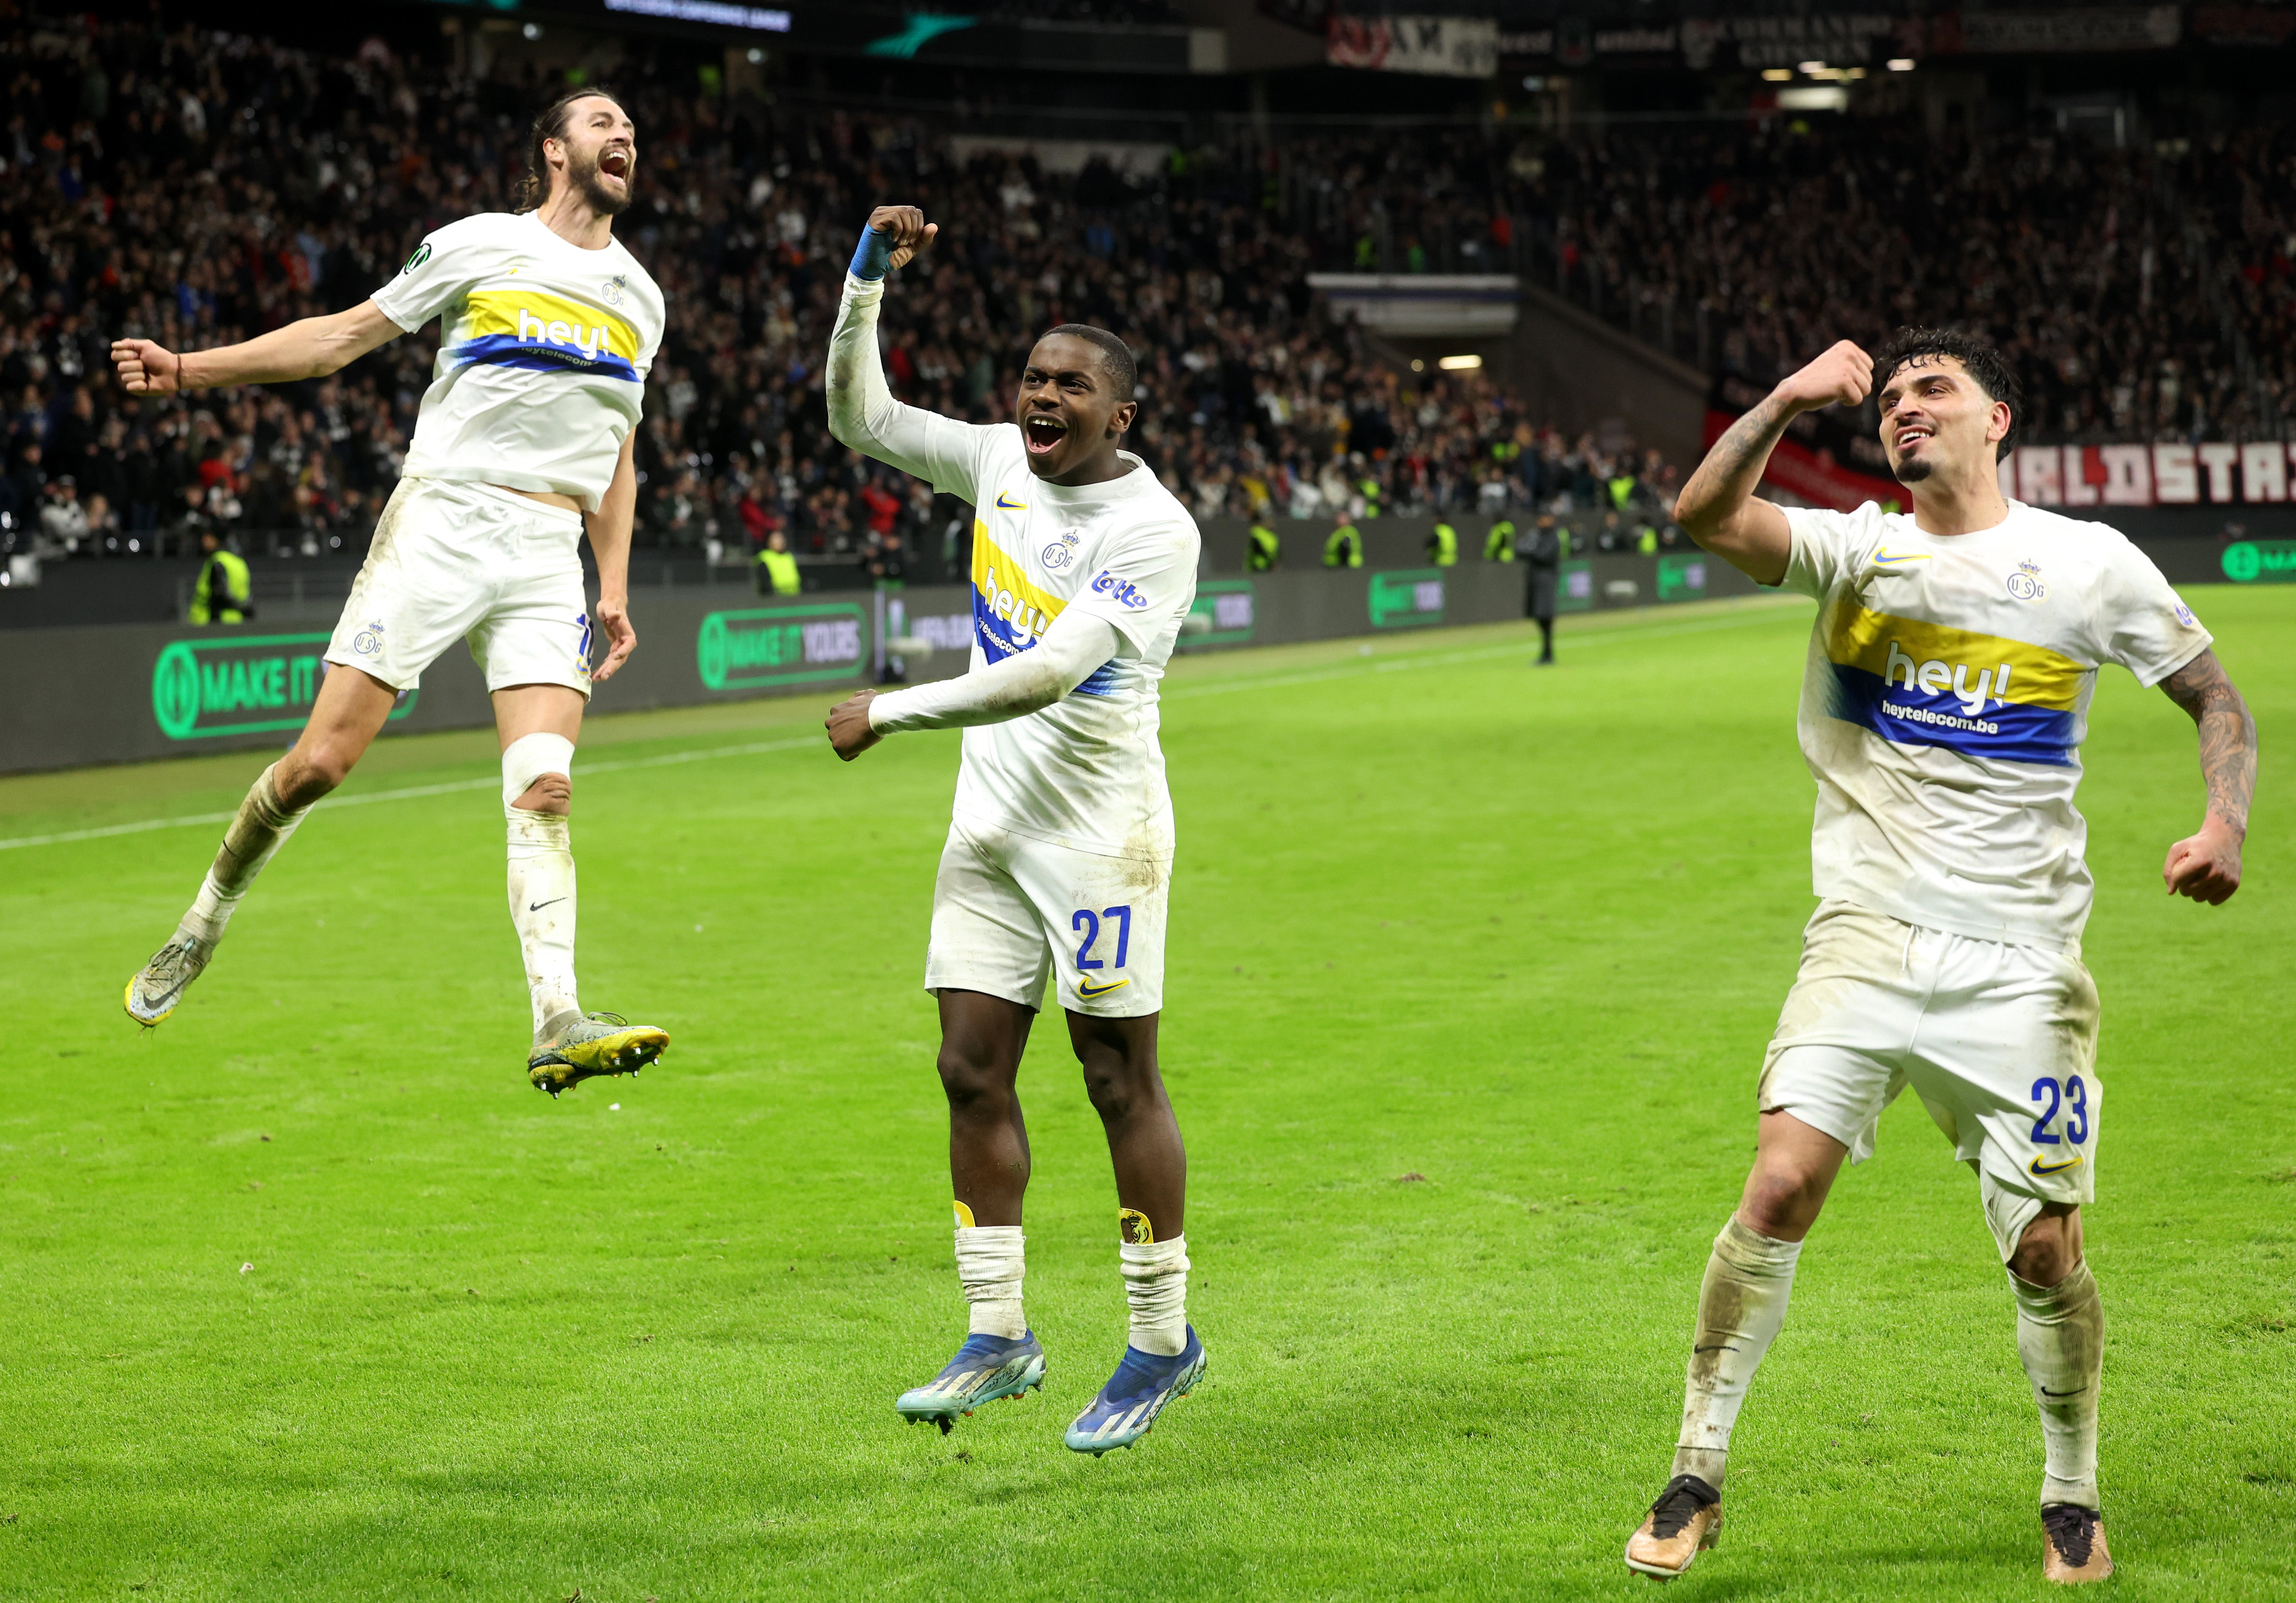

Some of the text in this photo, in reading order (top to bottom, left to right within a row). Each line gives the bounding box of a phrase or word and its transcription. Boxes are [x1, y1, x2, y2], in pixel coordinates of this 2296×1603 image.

[518, 308, 609, 360] hey!
[1046, 547, 1073, 567] USG
[985, 565, 1047, 646] hey!
[2012, 578, 2044, 598] USG
[357, 636, 382, 653] USG
[202, 657, 287, 713] MAKE
[290, 654, 318, 705] IT
[1885, 640, 2012, 716] hey!
[1882, 700, 1999, 735] heytelecom.be
[1072, 905, 1131, 969] 27
[2031, 1074, 2088, 1145] 23
